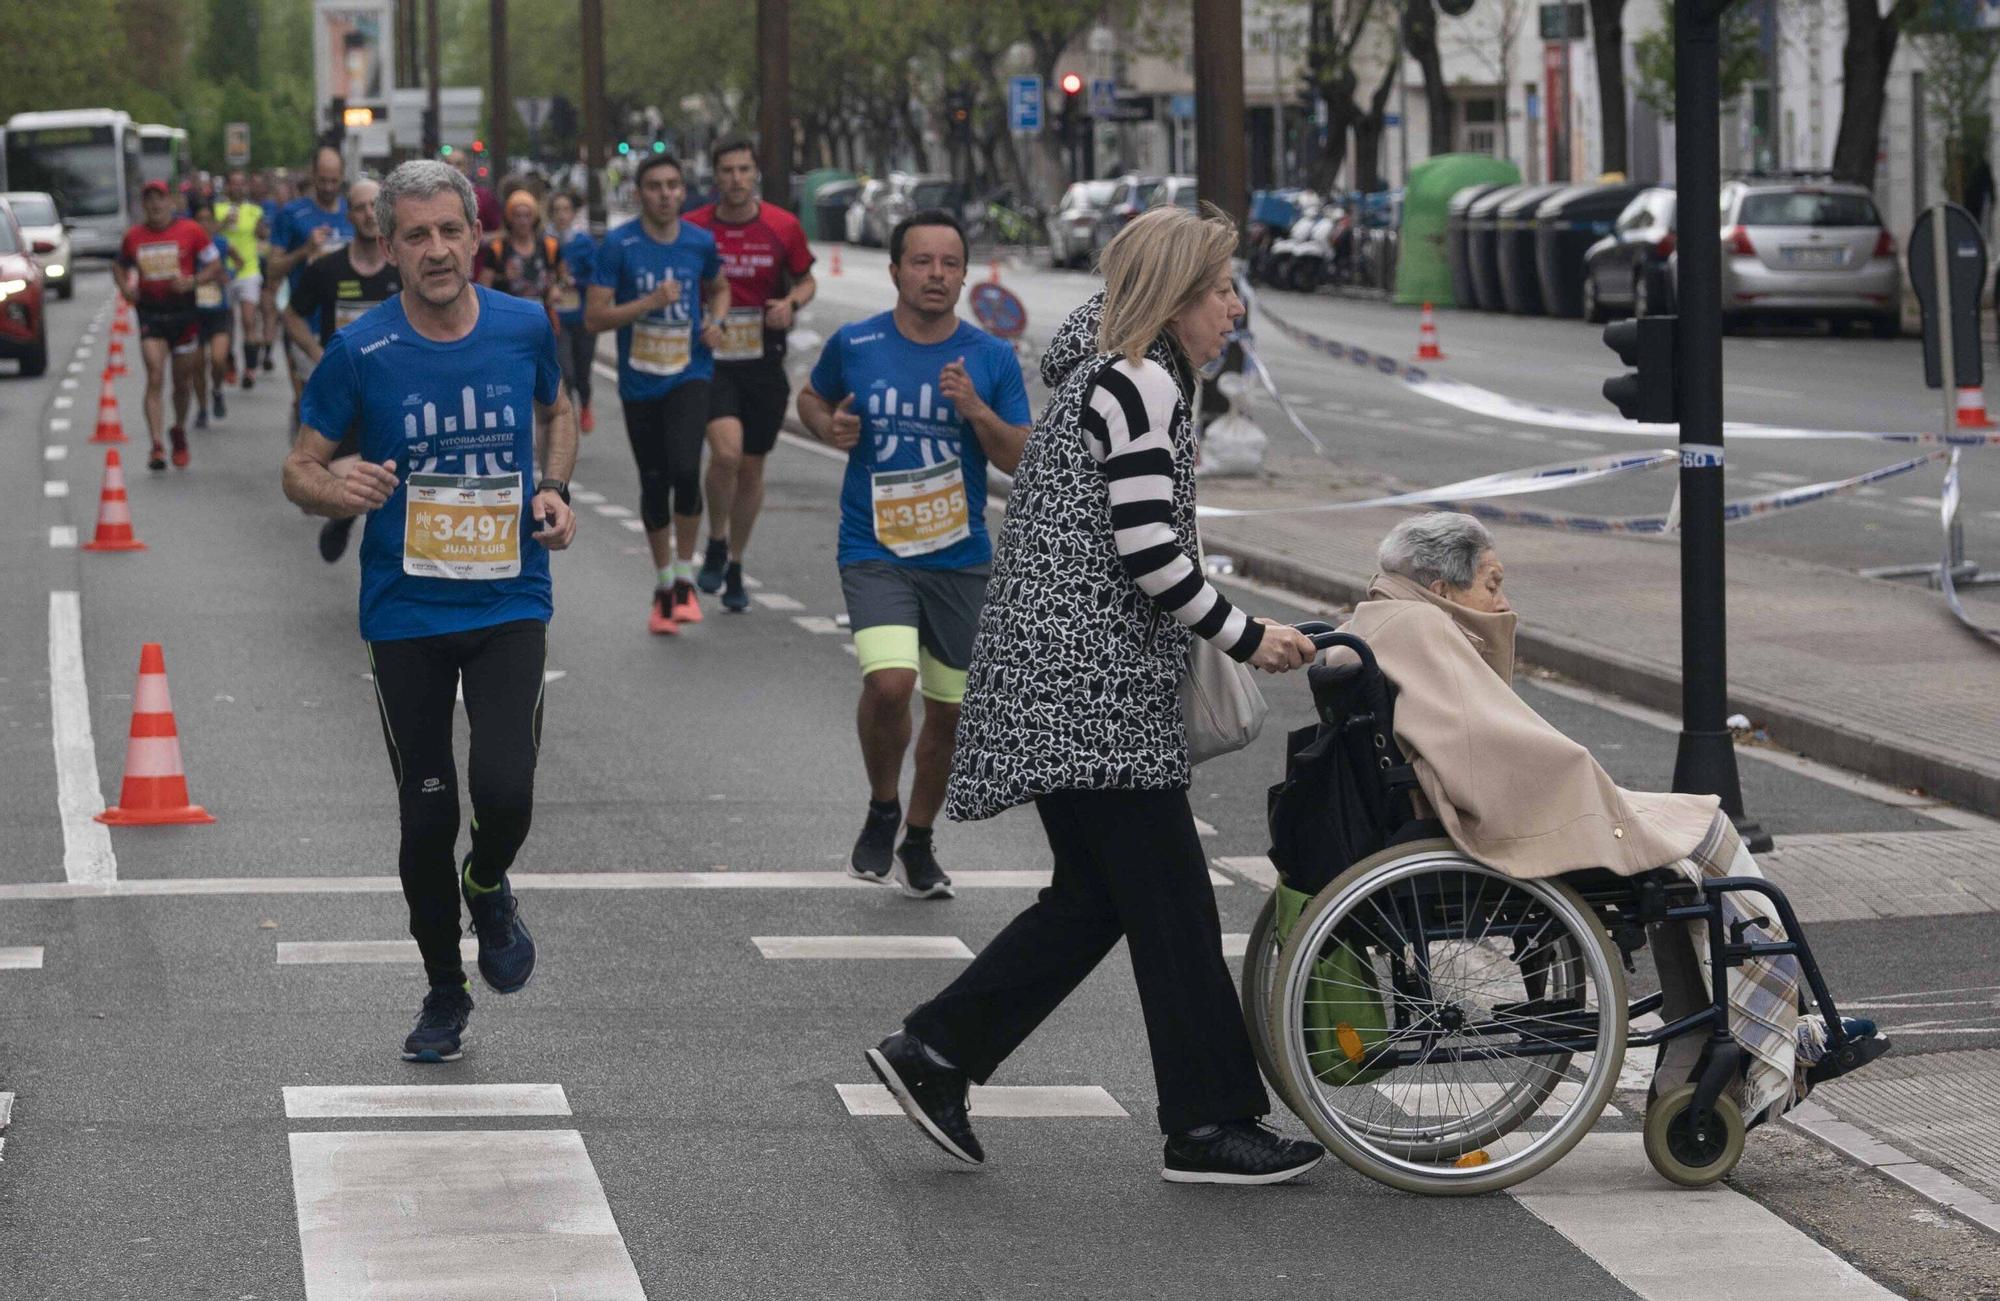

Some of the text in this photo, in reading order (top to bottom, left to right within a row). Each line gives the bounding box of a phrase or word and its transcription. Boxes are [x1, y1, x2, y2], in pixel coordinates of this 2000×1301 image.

[440, 433, 514, 447] VITORIA-GASTEIZ
[896, 490, 964, 527] 3595
[433, 513, 515, 542] 3497
[442, 543, 506, 555] JUAN LUIS
